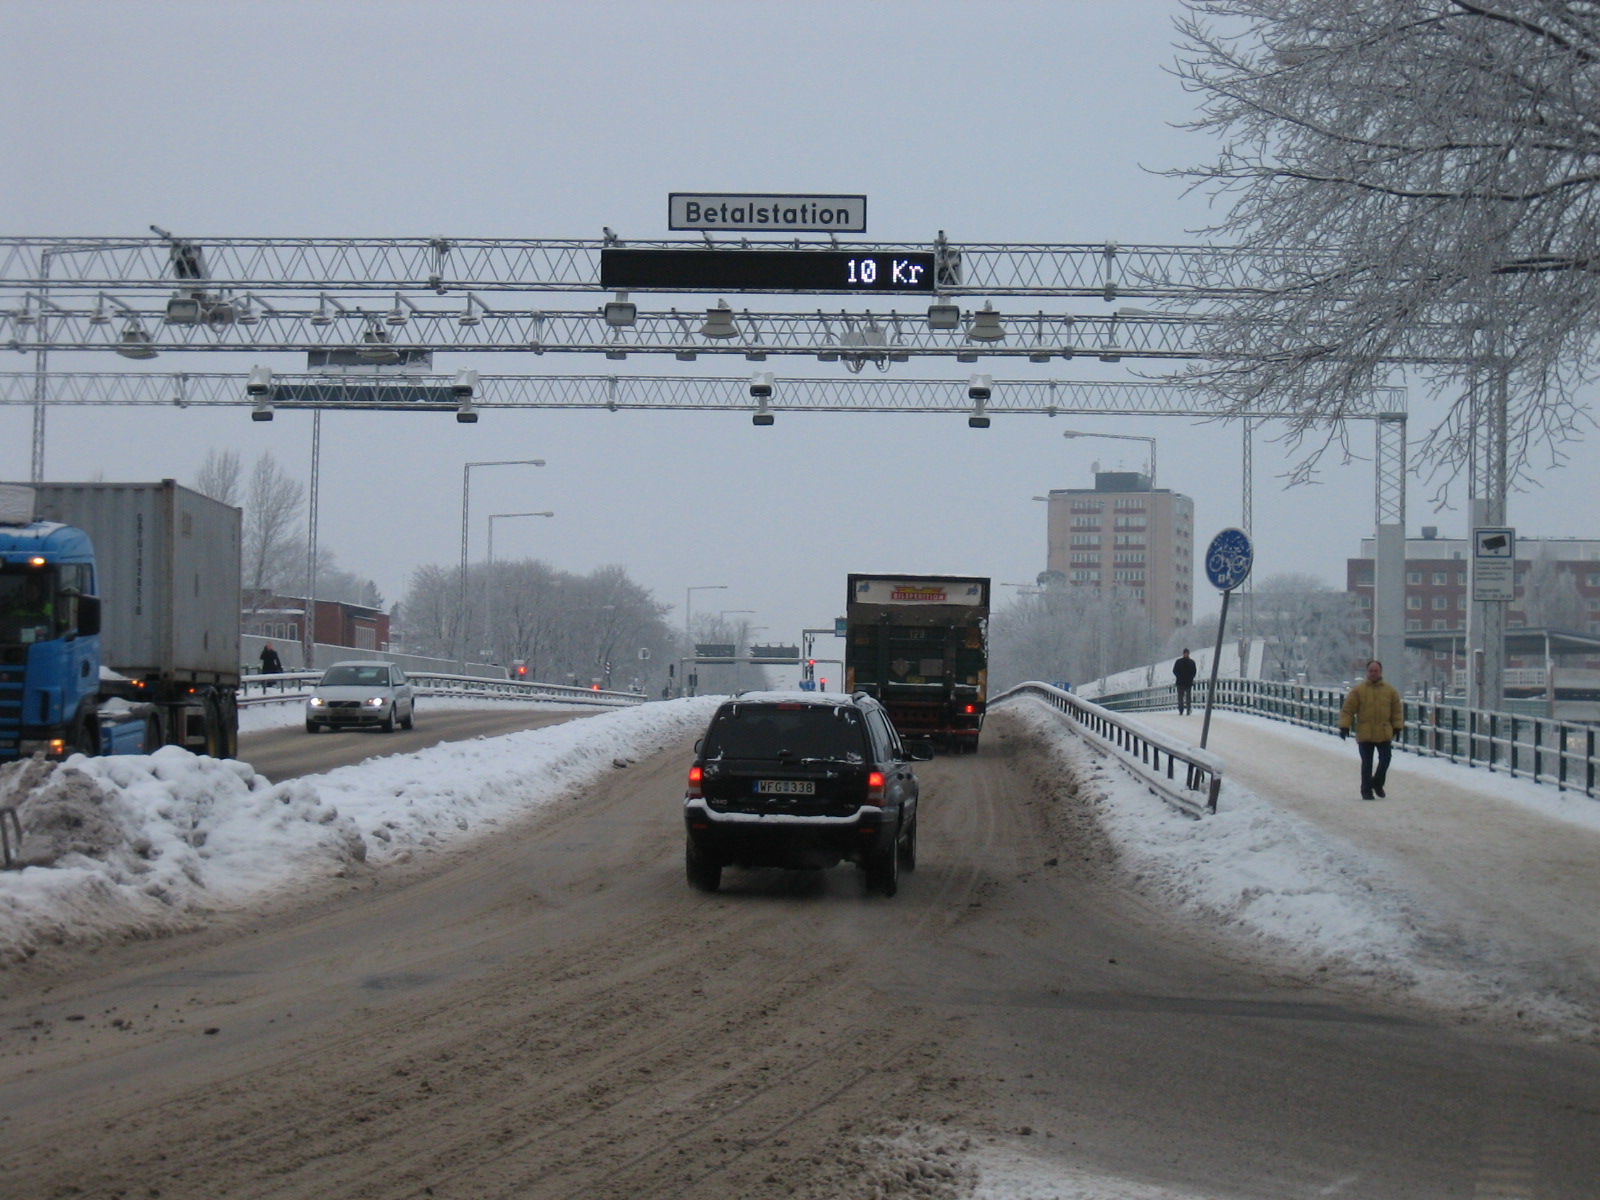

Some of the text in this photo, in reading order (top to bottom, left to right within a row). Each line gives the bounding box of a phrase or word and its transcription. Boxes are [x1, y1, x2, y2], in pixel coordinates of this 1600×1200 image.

[686, 202, 850, 224] Betalstation
[848, 259, 924, 284] 10 Kr
[760, 781, 813, 793] WFG 338
